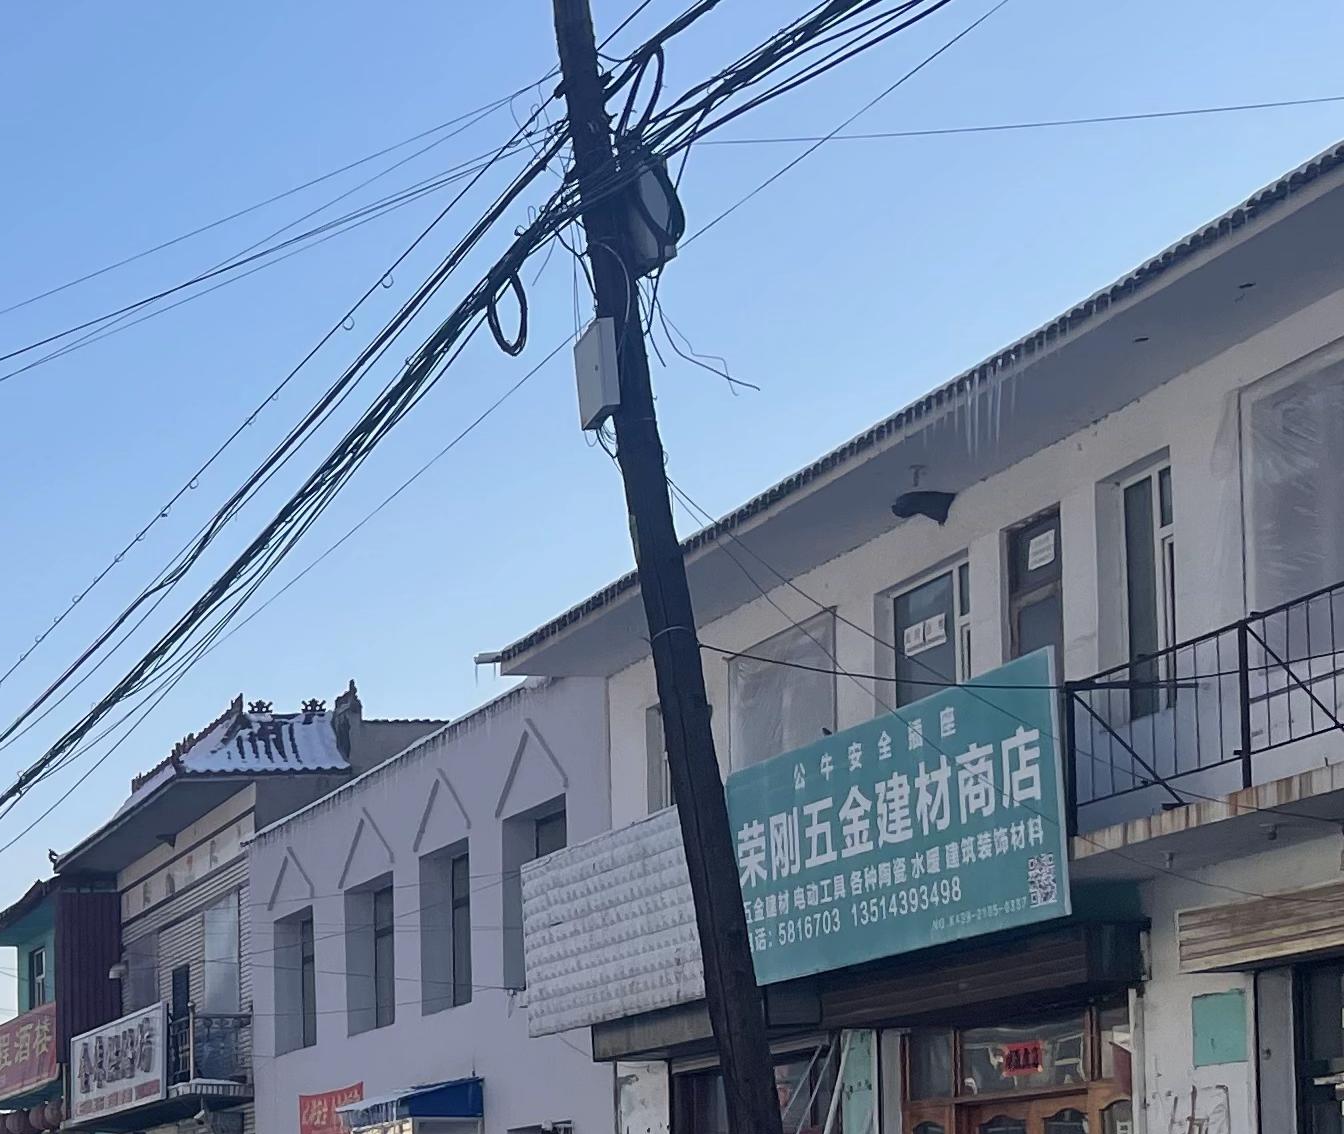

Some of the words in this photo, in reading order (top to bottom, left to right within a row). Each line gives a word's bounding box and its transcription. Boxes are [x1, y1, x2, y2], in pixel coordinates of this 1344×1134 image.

[737, 725, 1042, 888] 荣刚五金建材商店
[793, 873, 846, 910] 电动工具
[850, 856, 907, 896] 各种陶瓷
[911, 846, 940, 879] 水暖
[945, 814, 1044, 870] 建筑装饰材料
[851, 876, 962, 928] 13514393498
